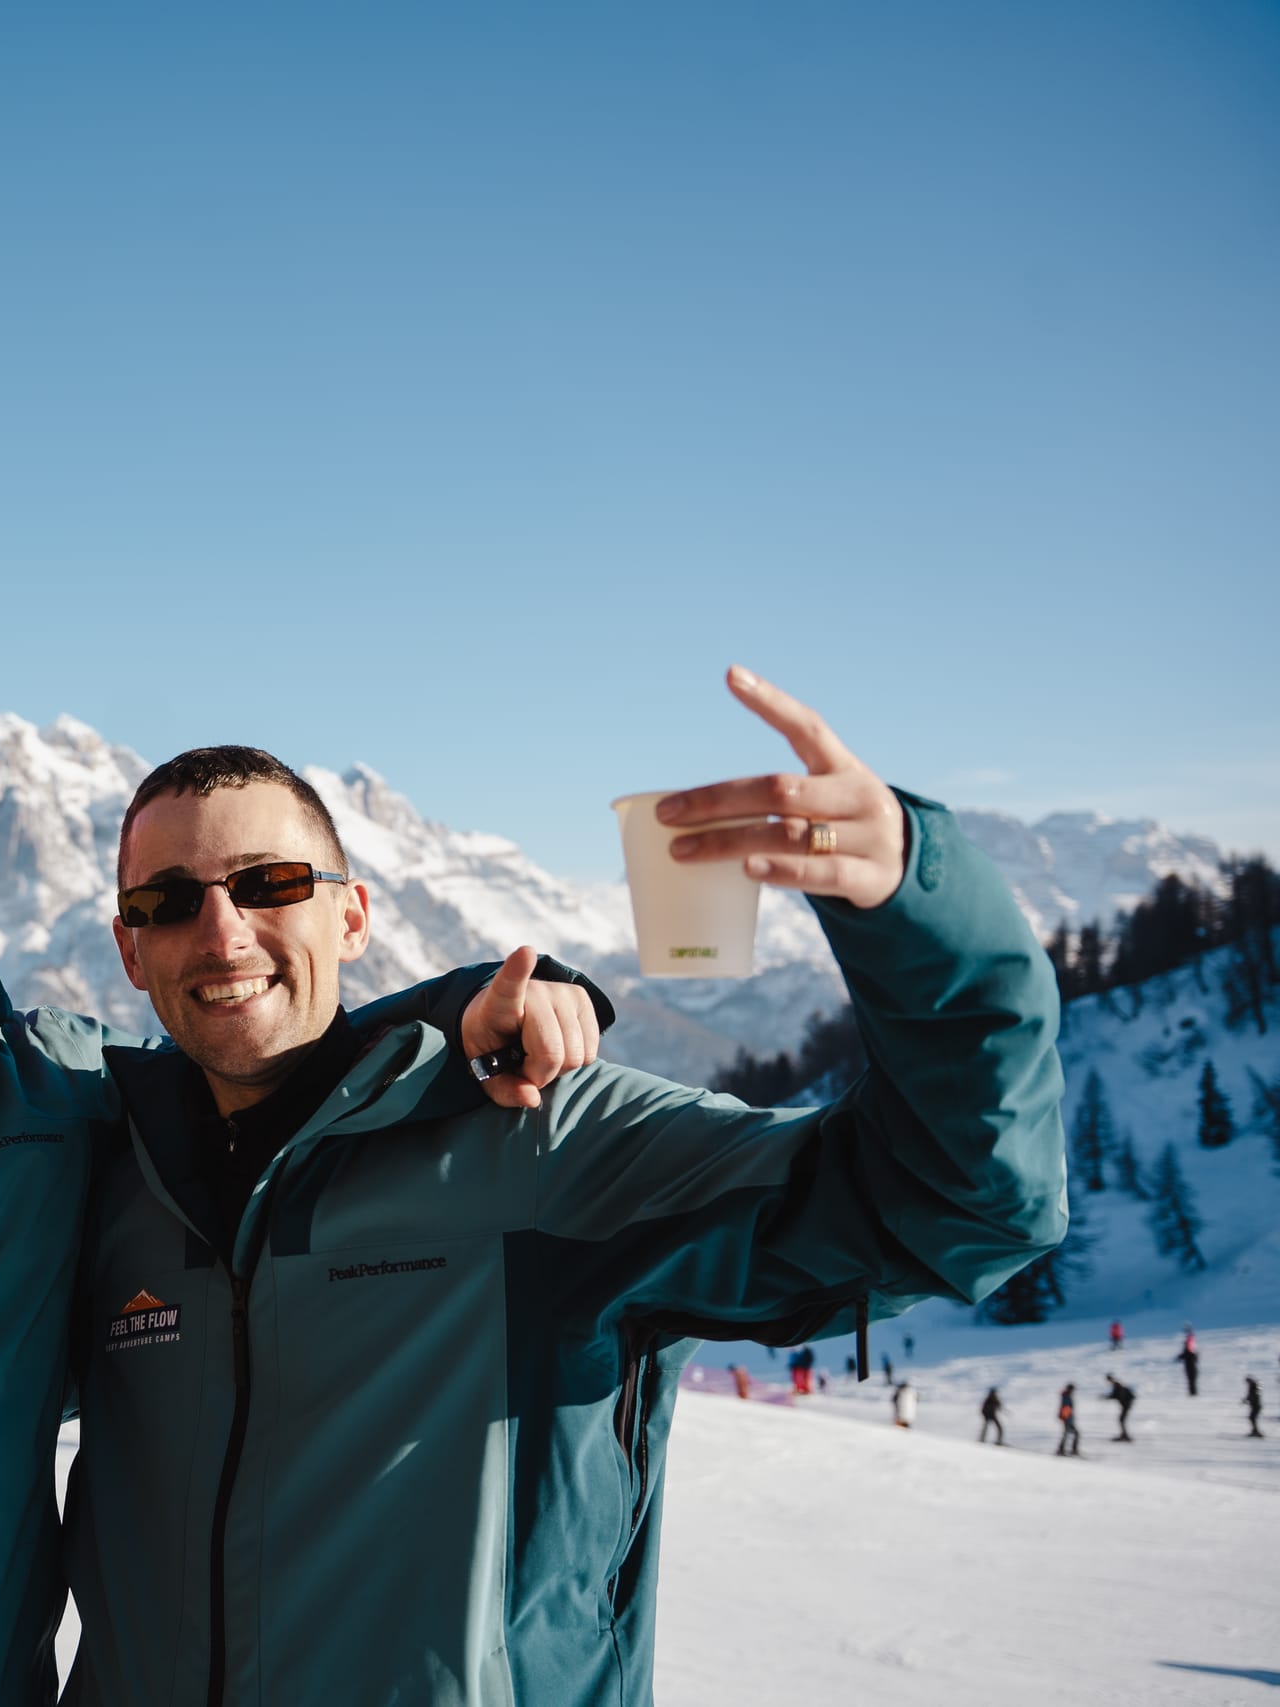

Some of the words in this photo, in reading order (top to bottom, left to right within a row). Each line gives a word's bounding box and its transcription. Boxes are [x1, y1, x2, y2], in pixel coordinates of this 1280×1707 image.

[110, 1319, 129, 1337] FEEL
[129, 1313, 146, 1333] THE
[148, 1309, 178, 1329] FLOW
[155, 1332, 181, 1343] CAMPS
